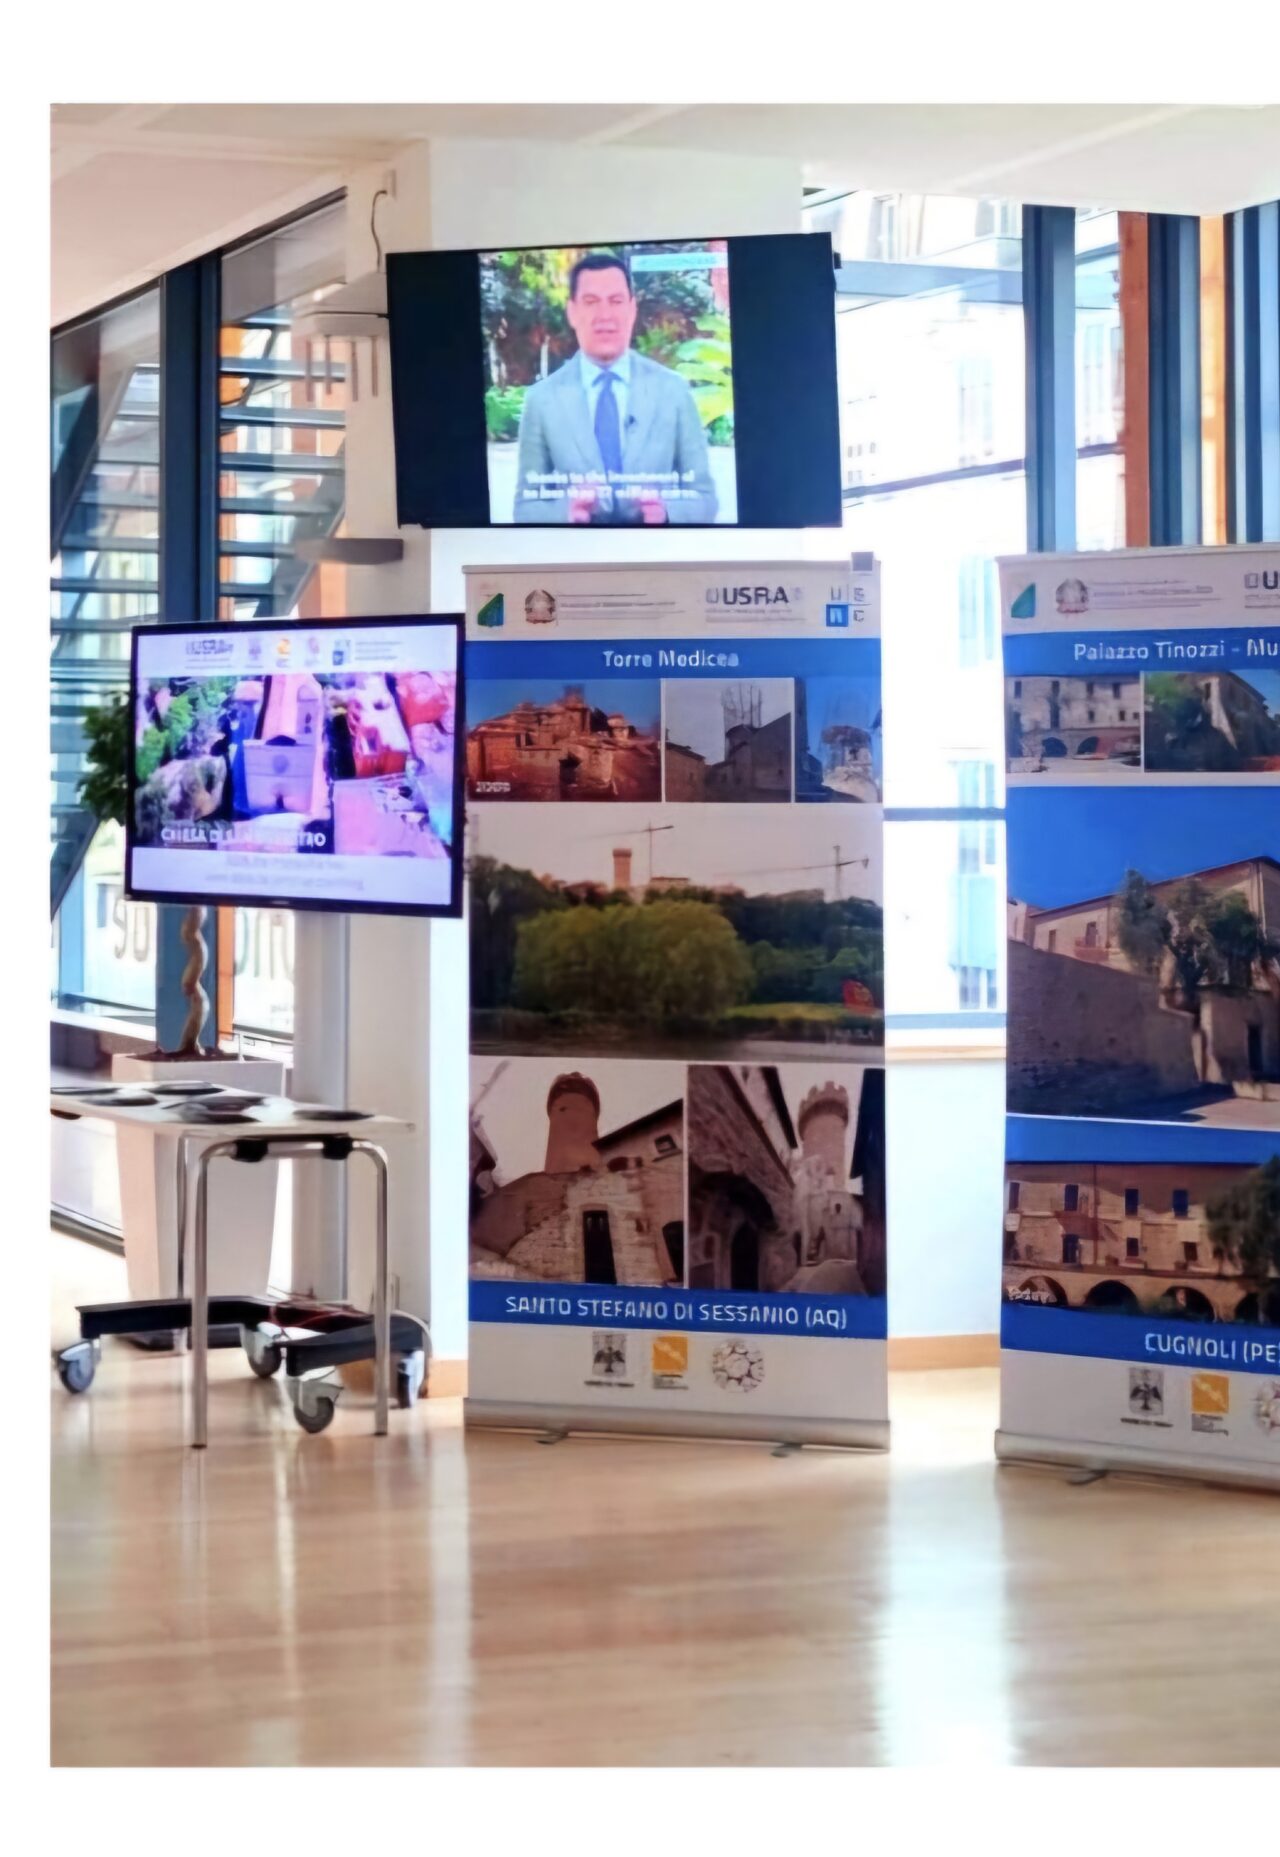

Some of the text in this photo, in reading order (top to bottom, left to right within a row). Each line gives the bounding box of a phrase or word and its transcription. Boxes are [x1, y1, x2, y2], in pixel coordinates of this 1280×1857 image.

[722, 586, 789, 605] USRA
[603, 648, 740, 668] Torre Medicea
[1074, 642, 1149, 661] Palazzo
[1153, 640, 1226, 659] Tinozzi
[505, 1296, 847, 1330] SANTO STEFANO DI SESSANIO (AQ)
[1144, 1332, 1236, 1361] CUGNOLI
